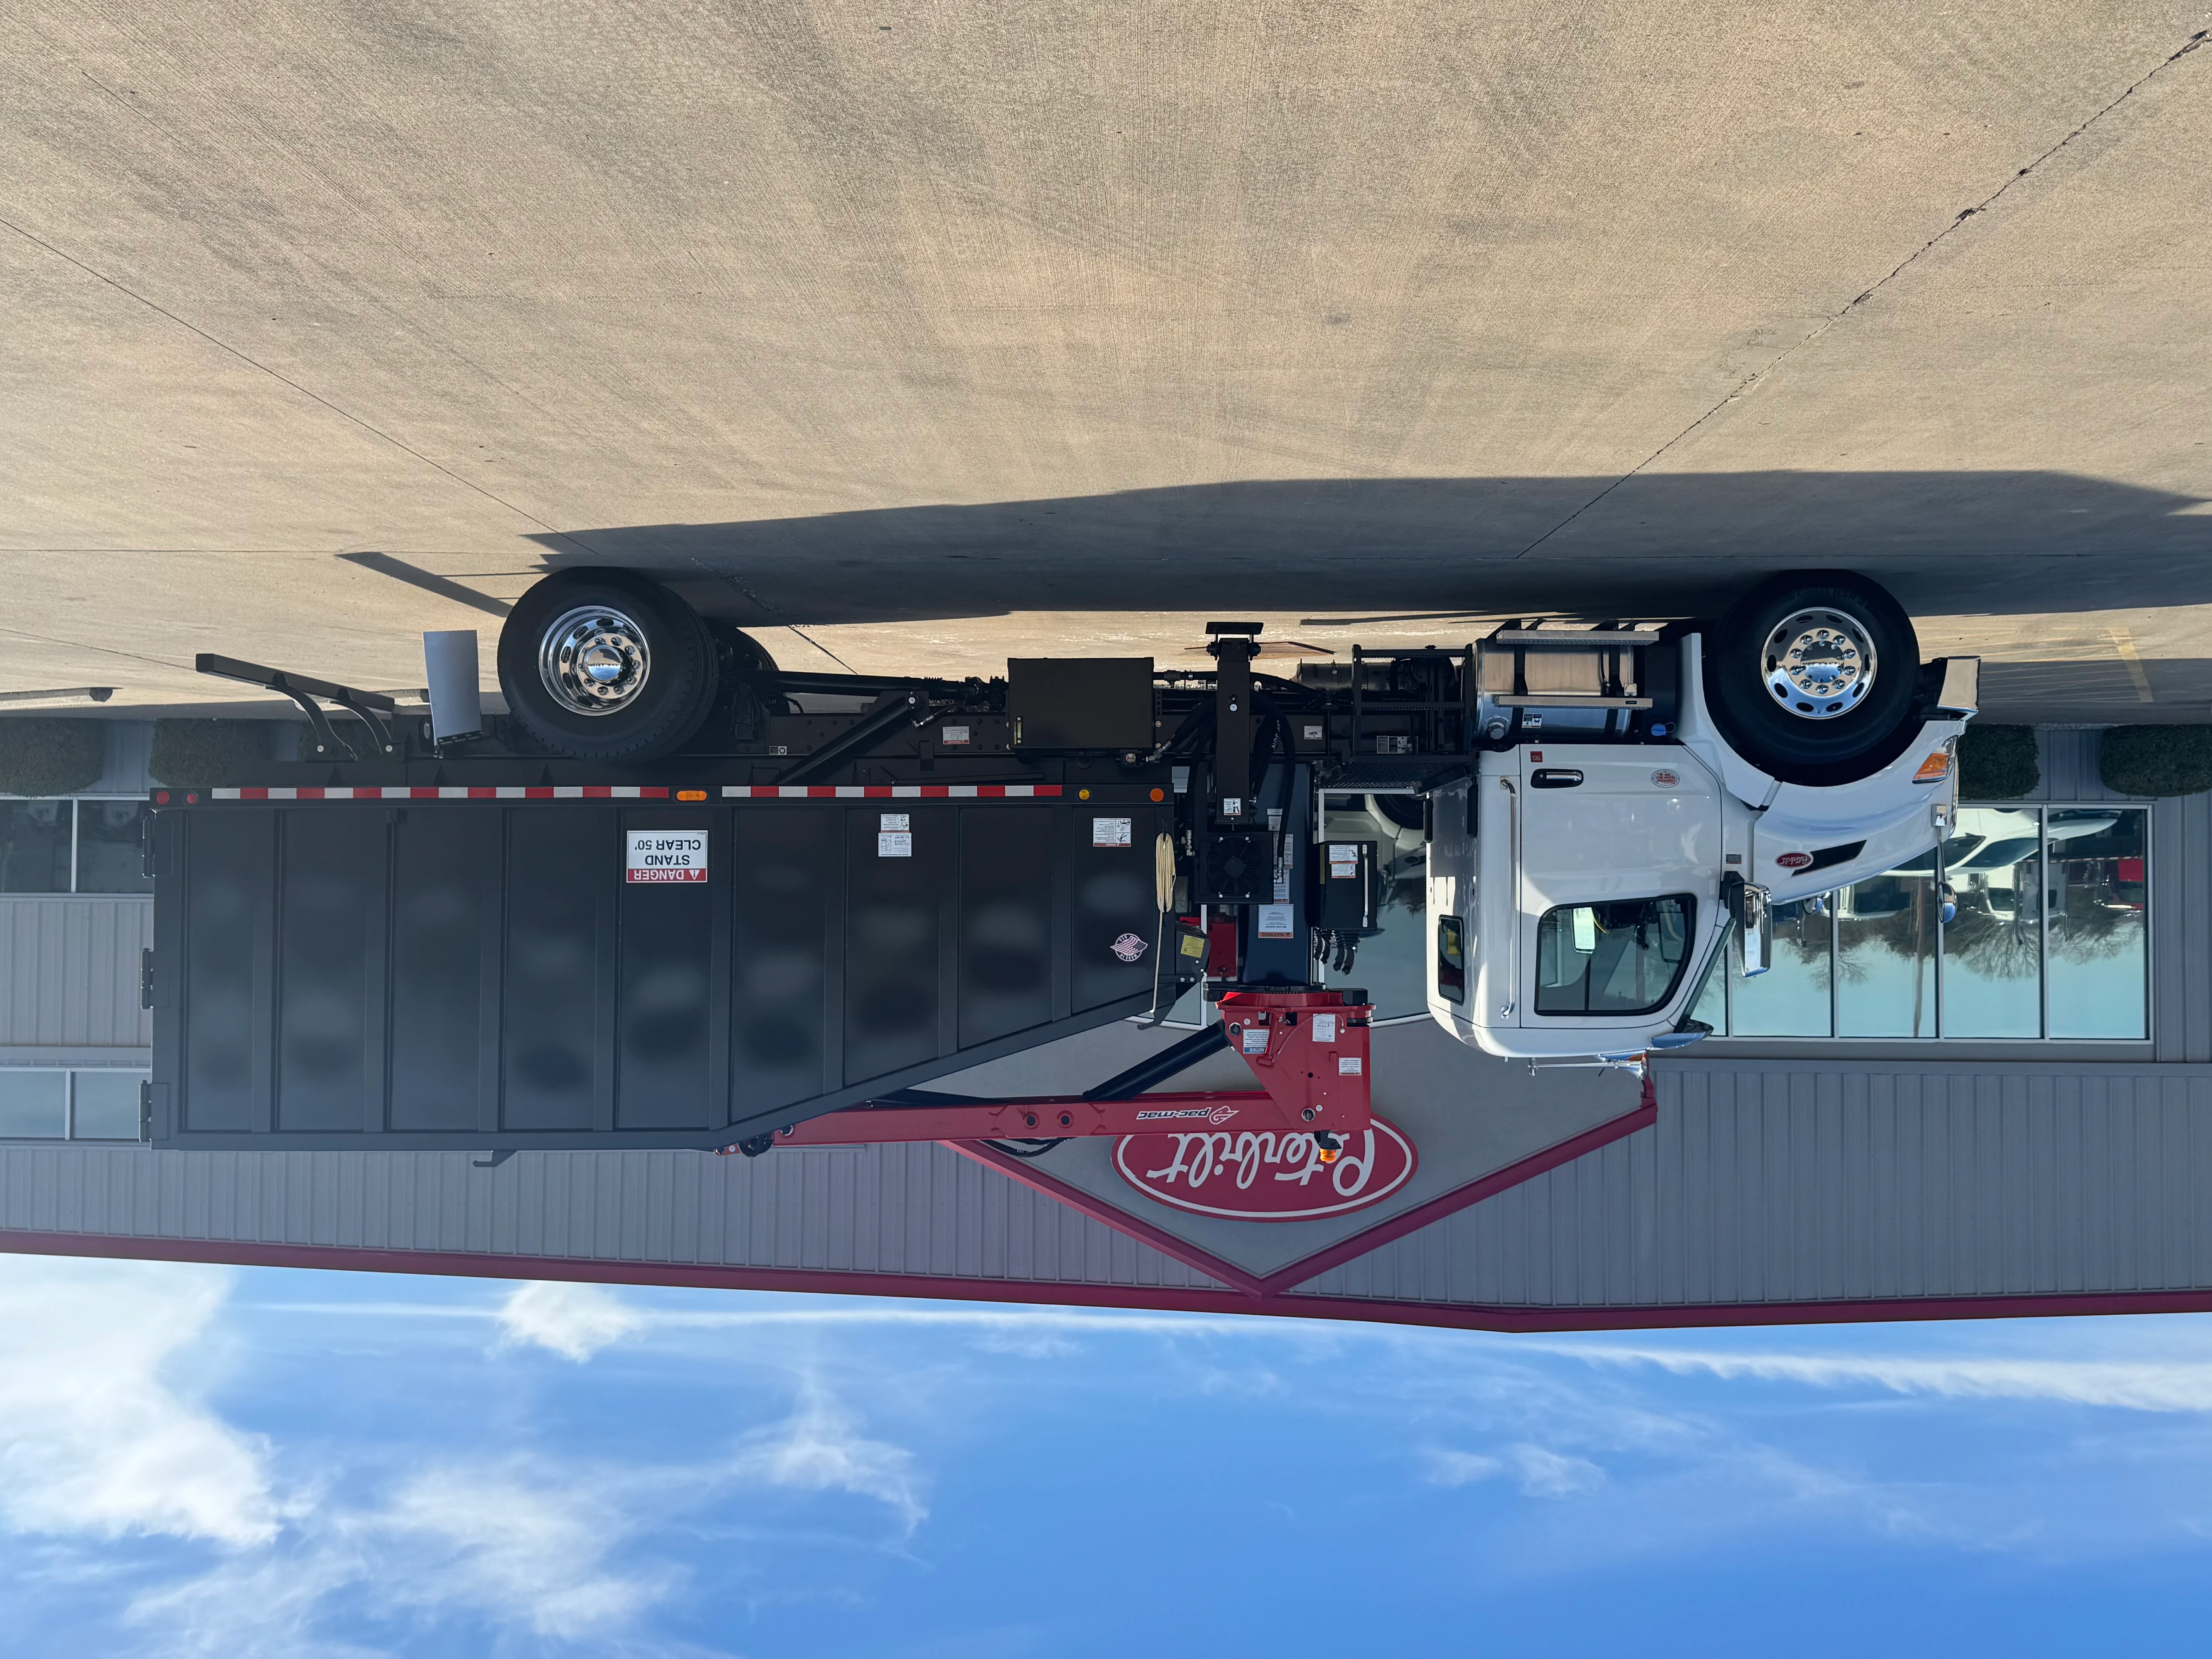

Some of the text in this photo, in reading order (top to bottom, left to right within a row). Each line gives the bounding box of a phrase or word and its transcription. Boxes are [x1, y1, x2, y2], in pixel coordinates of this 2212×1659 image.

[635, 840, 701, 850] CLEAR 50'
[645, 855, 690, 865] STAND
[1779, 855, 1807, 865] Peterbilt
[634, 869, 684, 880] DANGER
[1137, 1108, 1211, 1119] pac-mac
